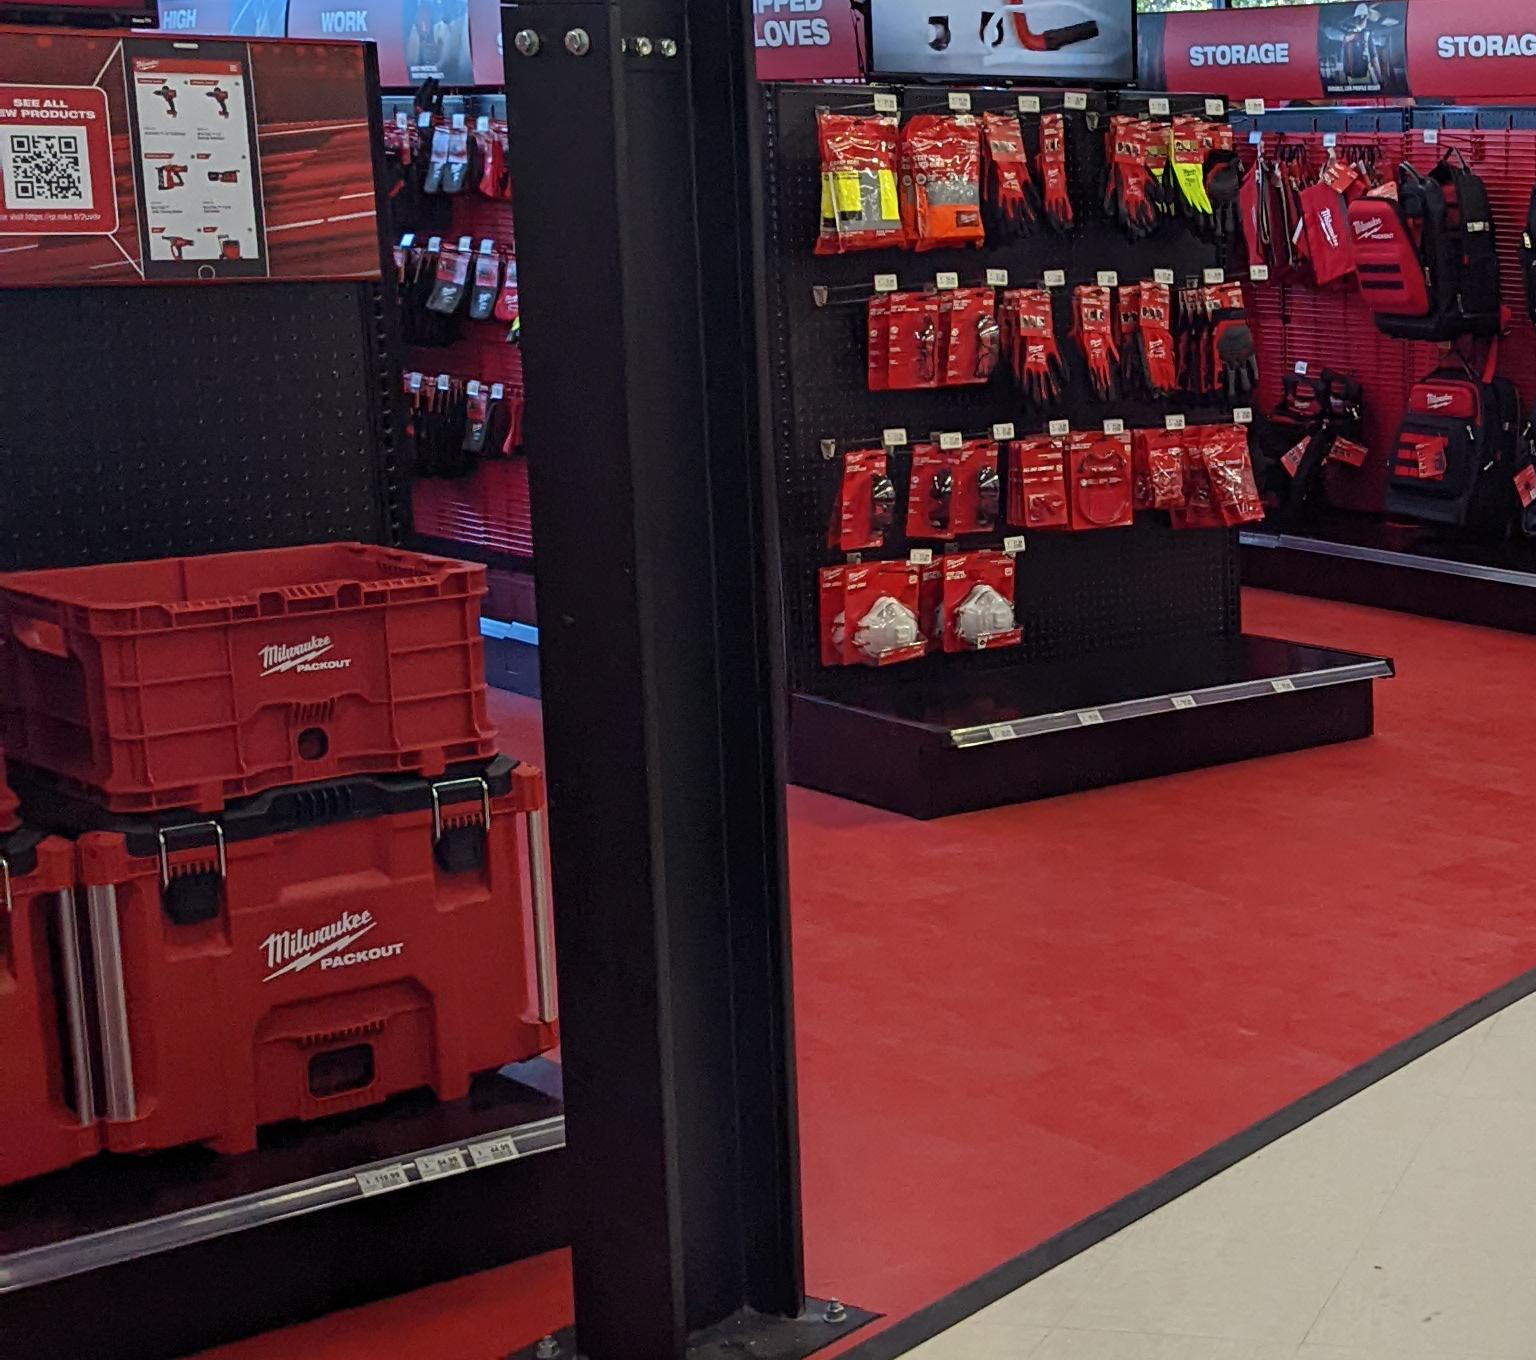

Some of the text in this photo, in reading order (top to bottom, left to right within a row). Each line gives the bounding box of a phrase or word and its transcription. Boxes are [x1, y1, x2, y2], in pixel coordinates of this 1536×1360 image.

[163, 9, 196, 30] HIGH
[321, 10, 368, 33] WORK
[754, 19, 831, 48] LOVES
[1189, 43, 1290, 67] STORAGE
[13, 99, 68, 108] SEE ALL
[21, 110, 96, 119] PRODUCTS
[258, 636, 331, 668] Milwaukee
[297, 659, 351, 672] PACKOUT
[259, 910, 373, 968] Milwaukee
[321, 943, 404, 970] PACKOUT
